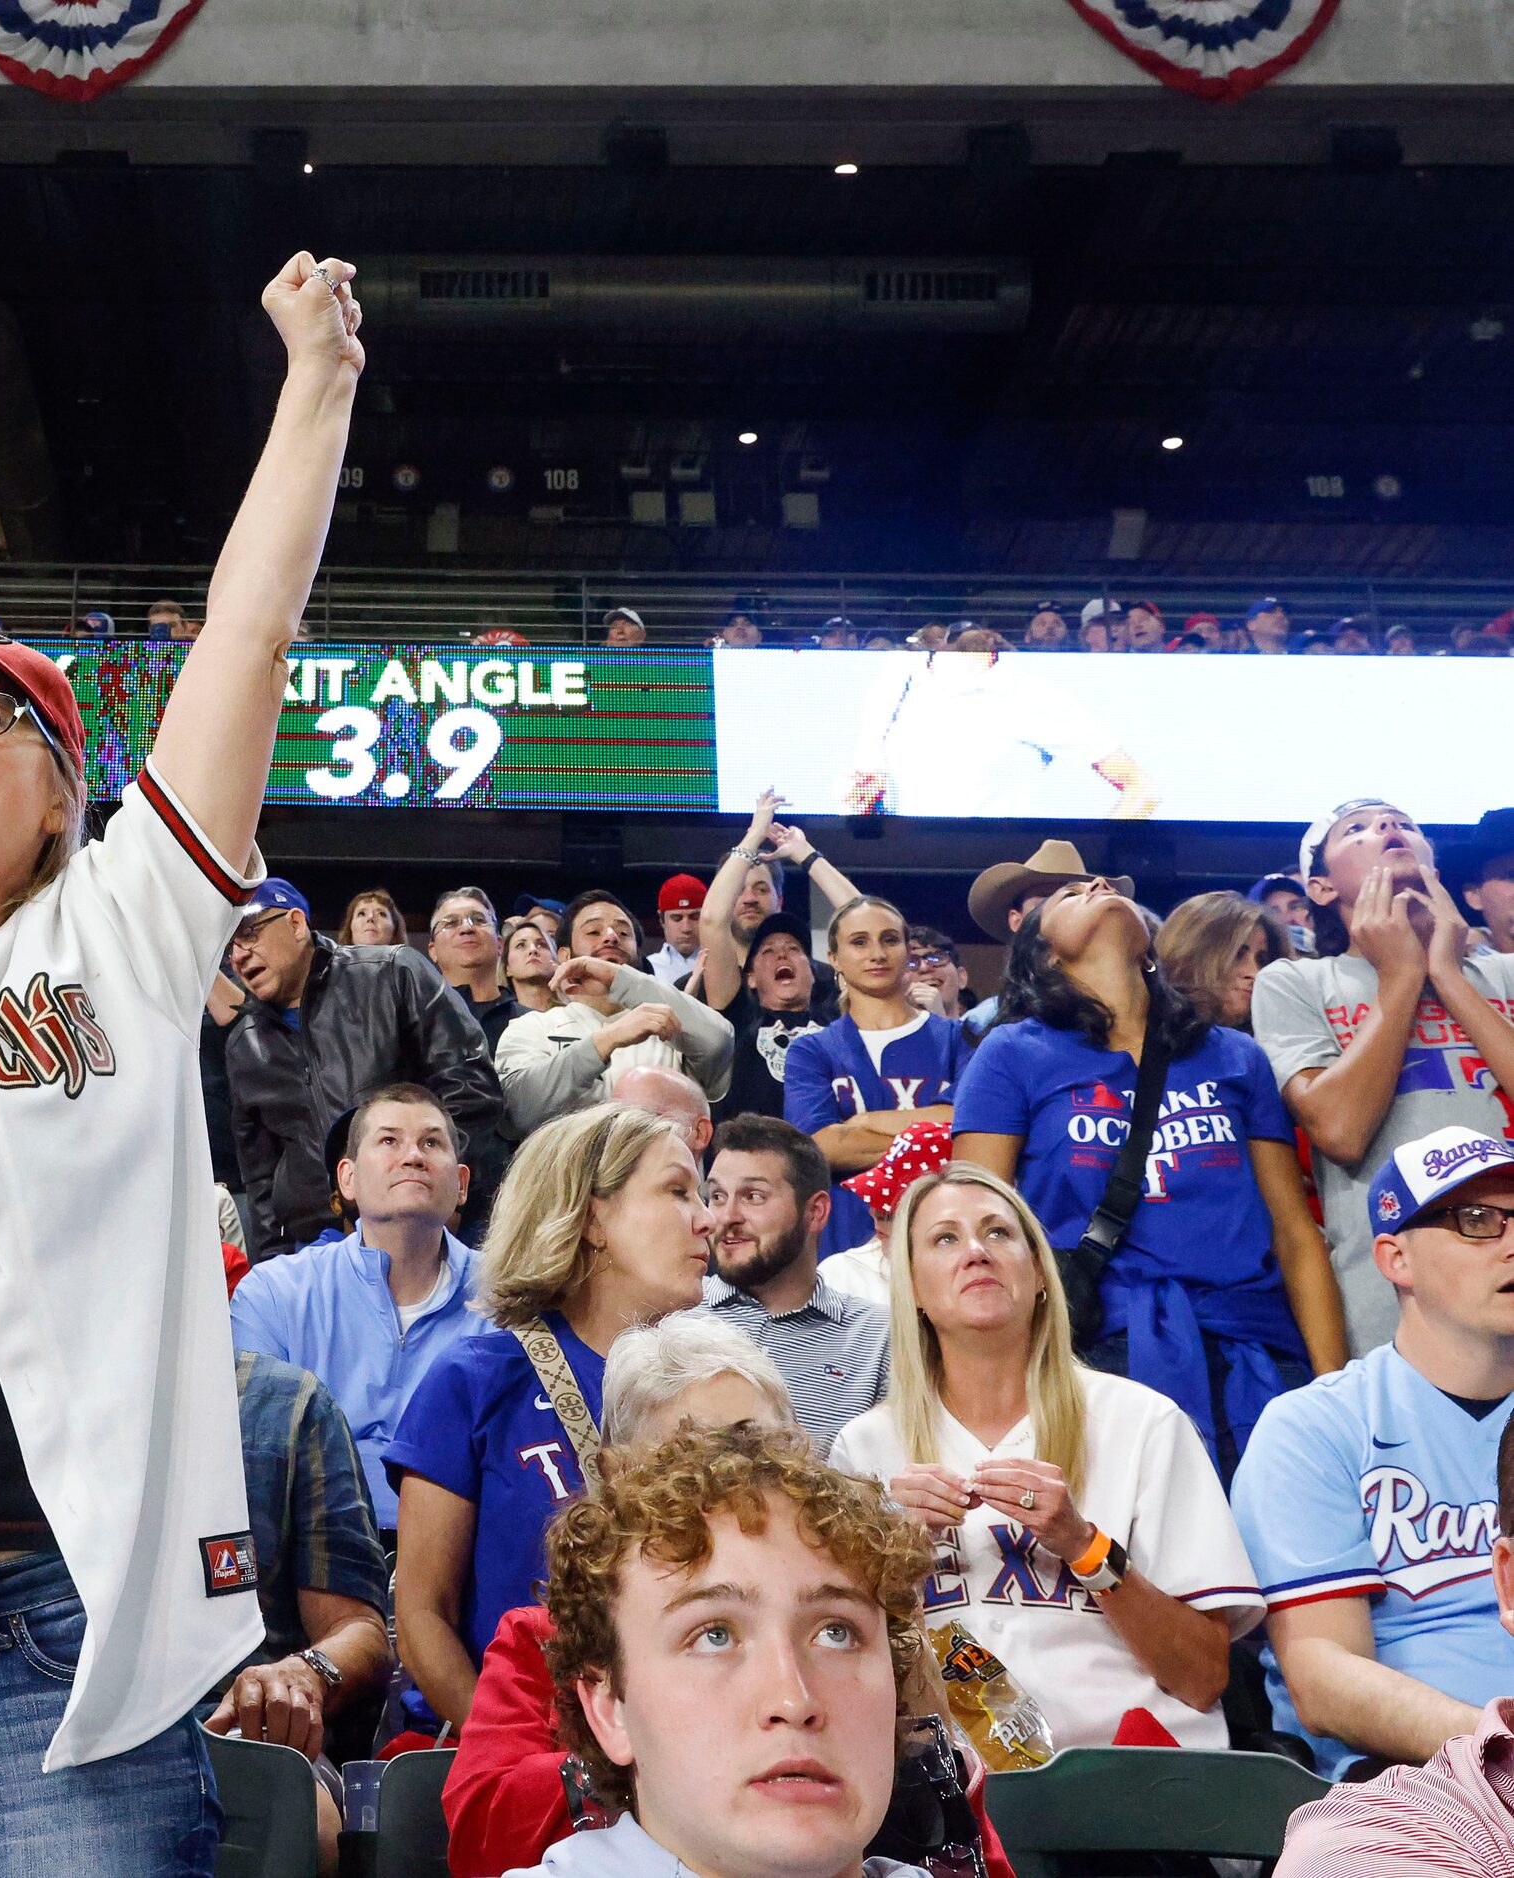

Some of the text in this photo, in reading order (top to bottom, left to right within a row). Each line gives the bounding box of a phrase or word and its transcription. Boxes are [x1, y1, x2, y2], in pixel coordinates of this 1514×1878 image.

[337, 466, 365, 489] 09
[543, 468, 580, 491] 108
[368, 659, 588, 706] ANGLE
[305, 705, 503, 800] 3.9
